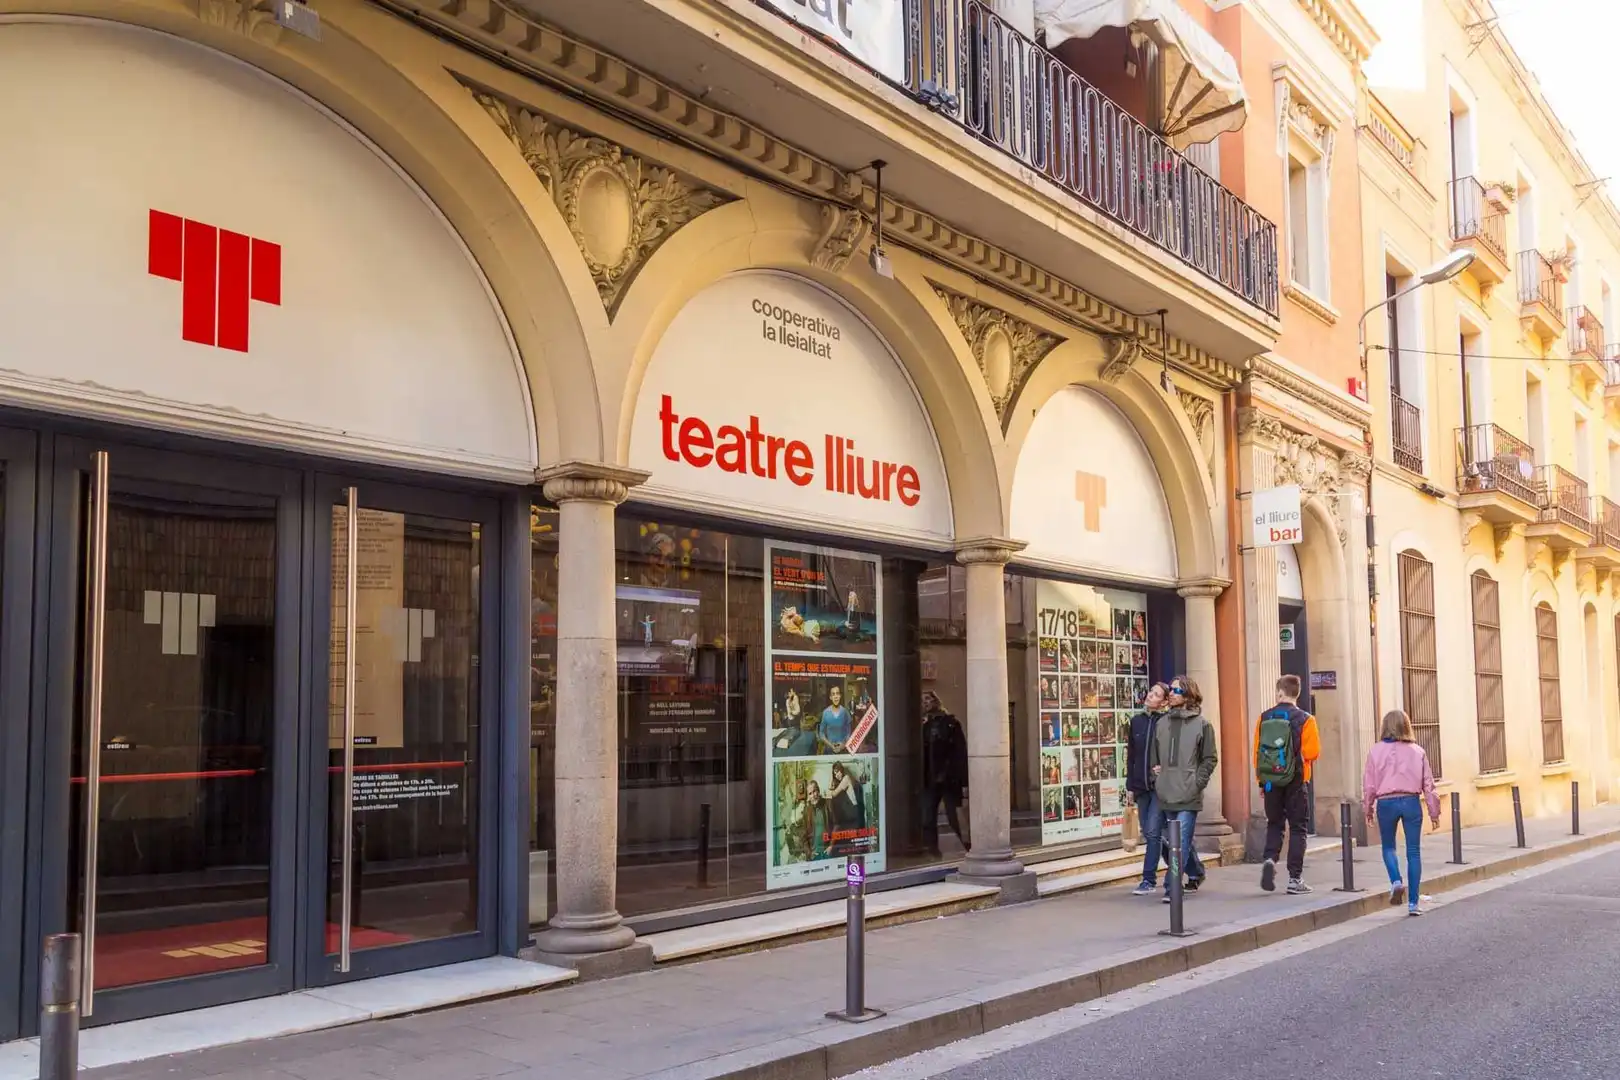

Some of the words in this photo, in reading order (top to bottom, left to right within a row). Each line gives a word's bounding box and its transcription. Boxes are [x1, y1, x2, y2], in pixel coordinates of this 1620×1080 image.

[752, 299, 840, 341] cooperativa
[763, 319, 776, 342] la
[779, 325, 831, 360] lleialtat
[659, 394, 814, 486] teatre
[825, 434, 920, 507] lliure
[1255, 511, 1266, 525] el
[1269, 511, 1299, 523] lliure
[1270, 527, 1300, 542] bar
[1039, 607, 1078, 637] 17/18
[774, 662, 782, 671] EL
